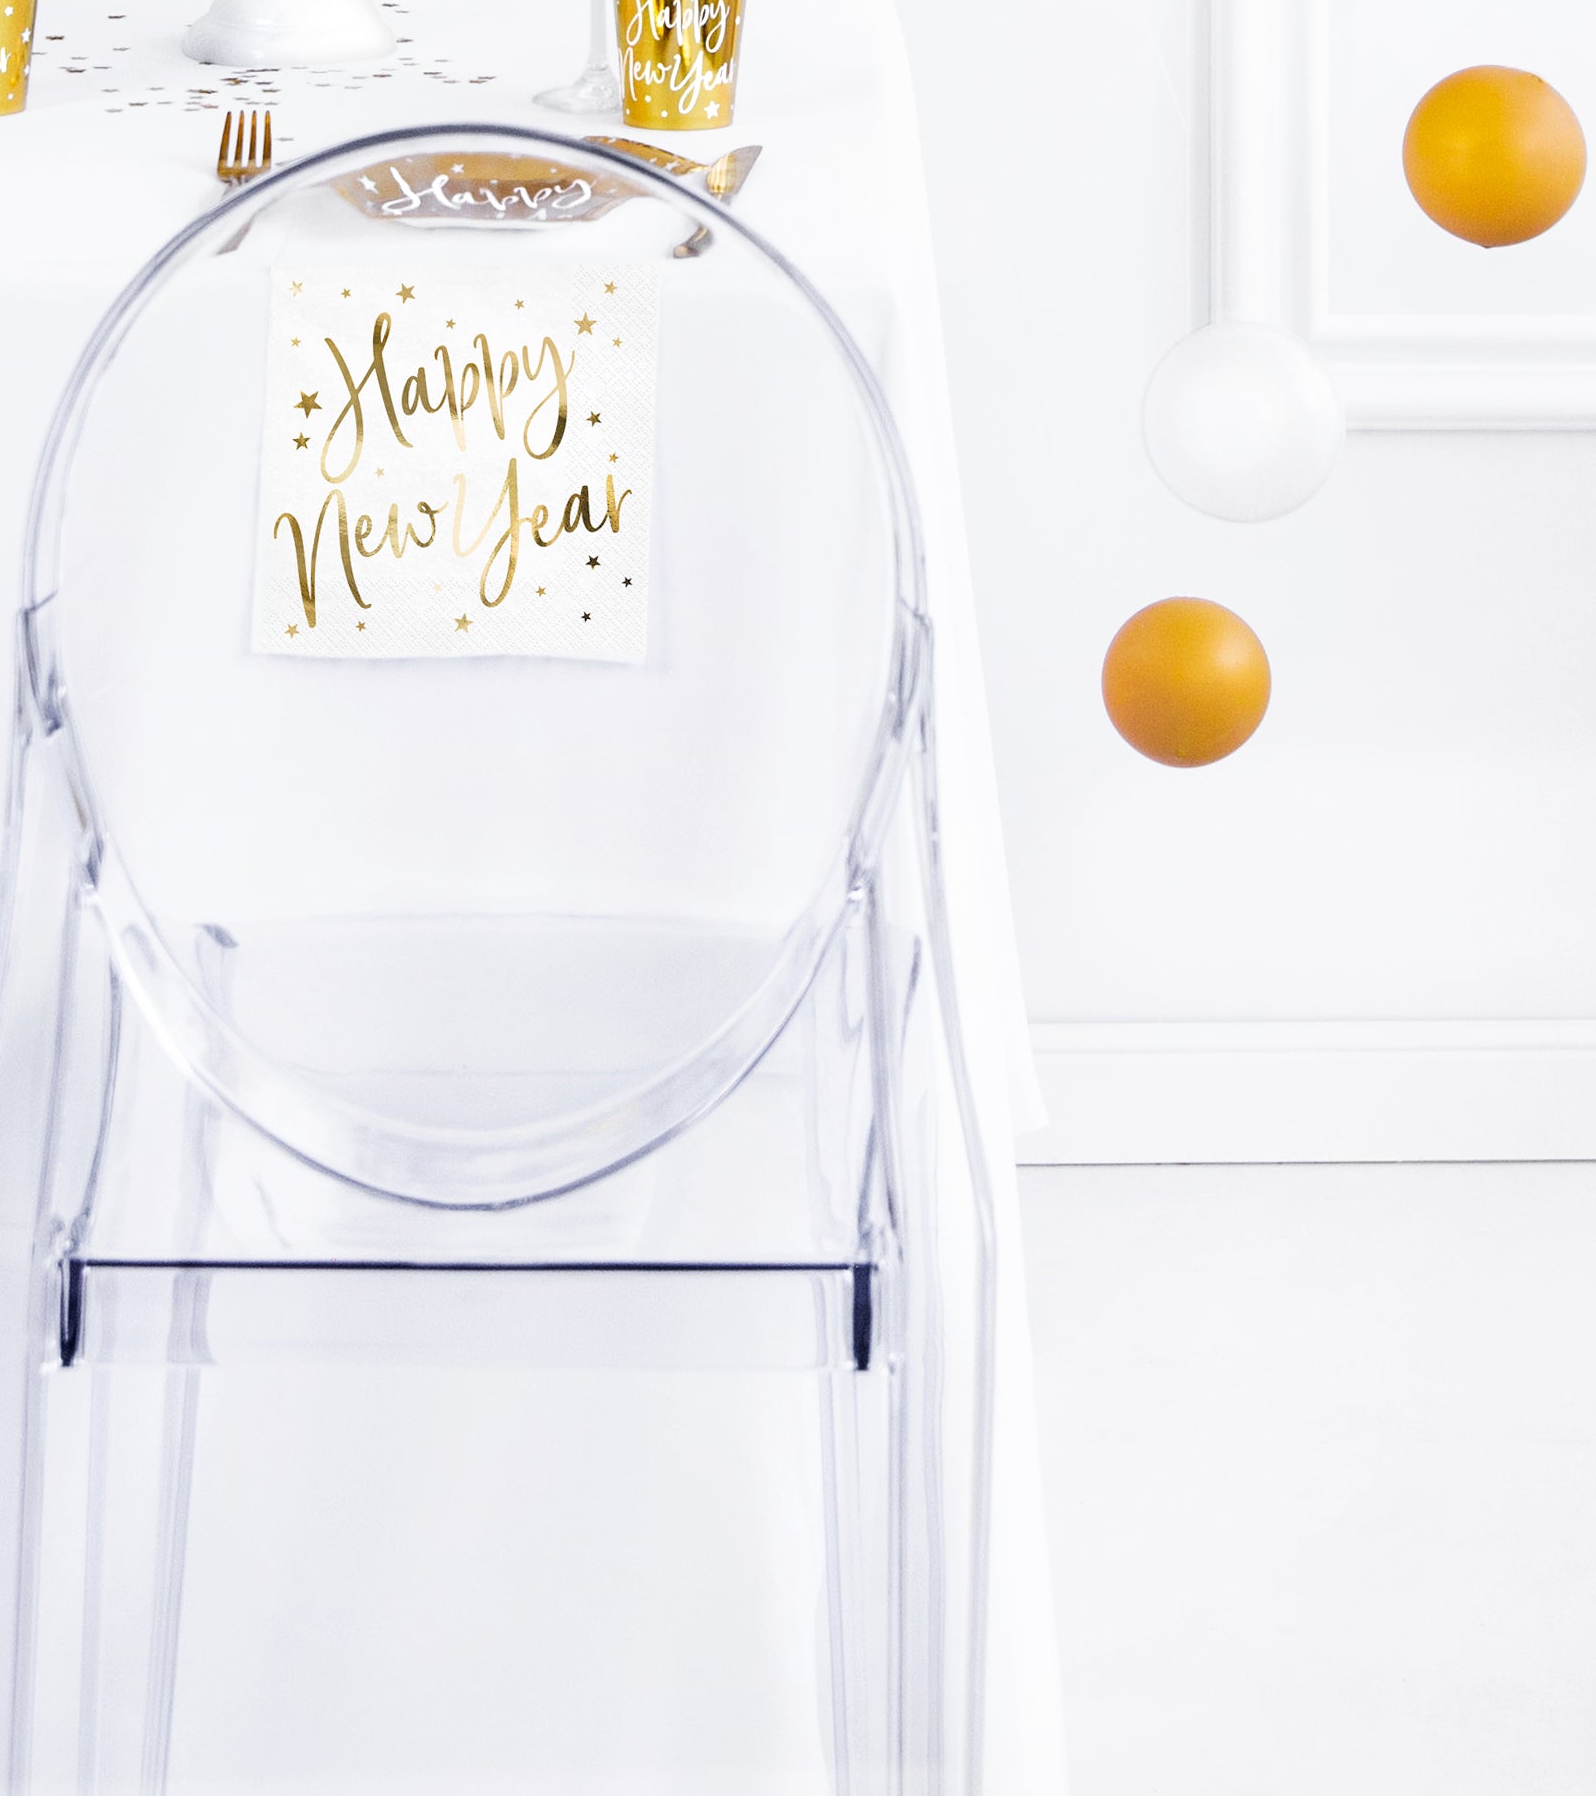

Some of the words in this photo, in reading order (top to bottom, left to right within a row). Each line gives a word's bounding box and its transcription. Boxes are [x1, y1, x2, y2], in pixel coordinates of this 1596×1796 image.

[619, 46, 672, 102] New
[382, 167, 597, 213] Happy
[319, 311, 576, 484] Happy
[273, 489, 449, 629] New
[451, 458, 633, 607] Year
